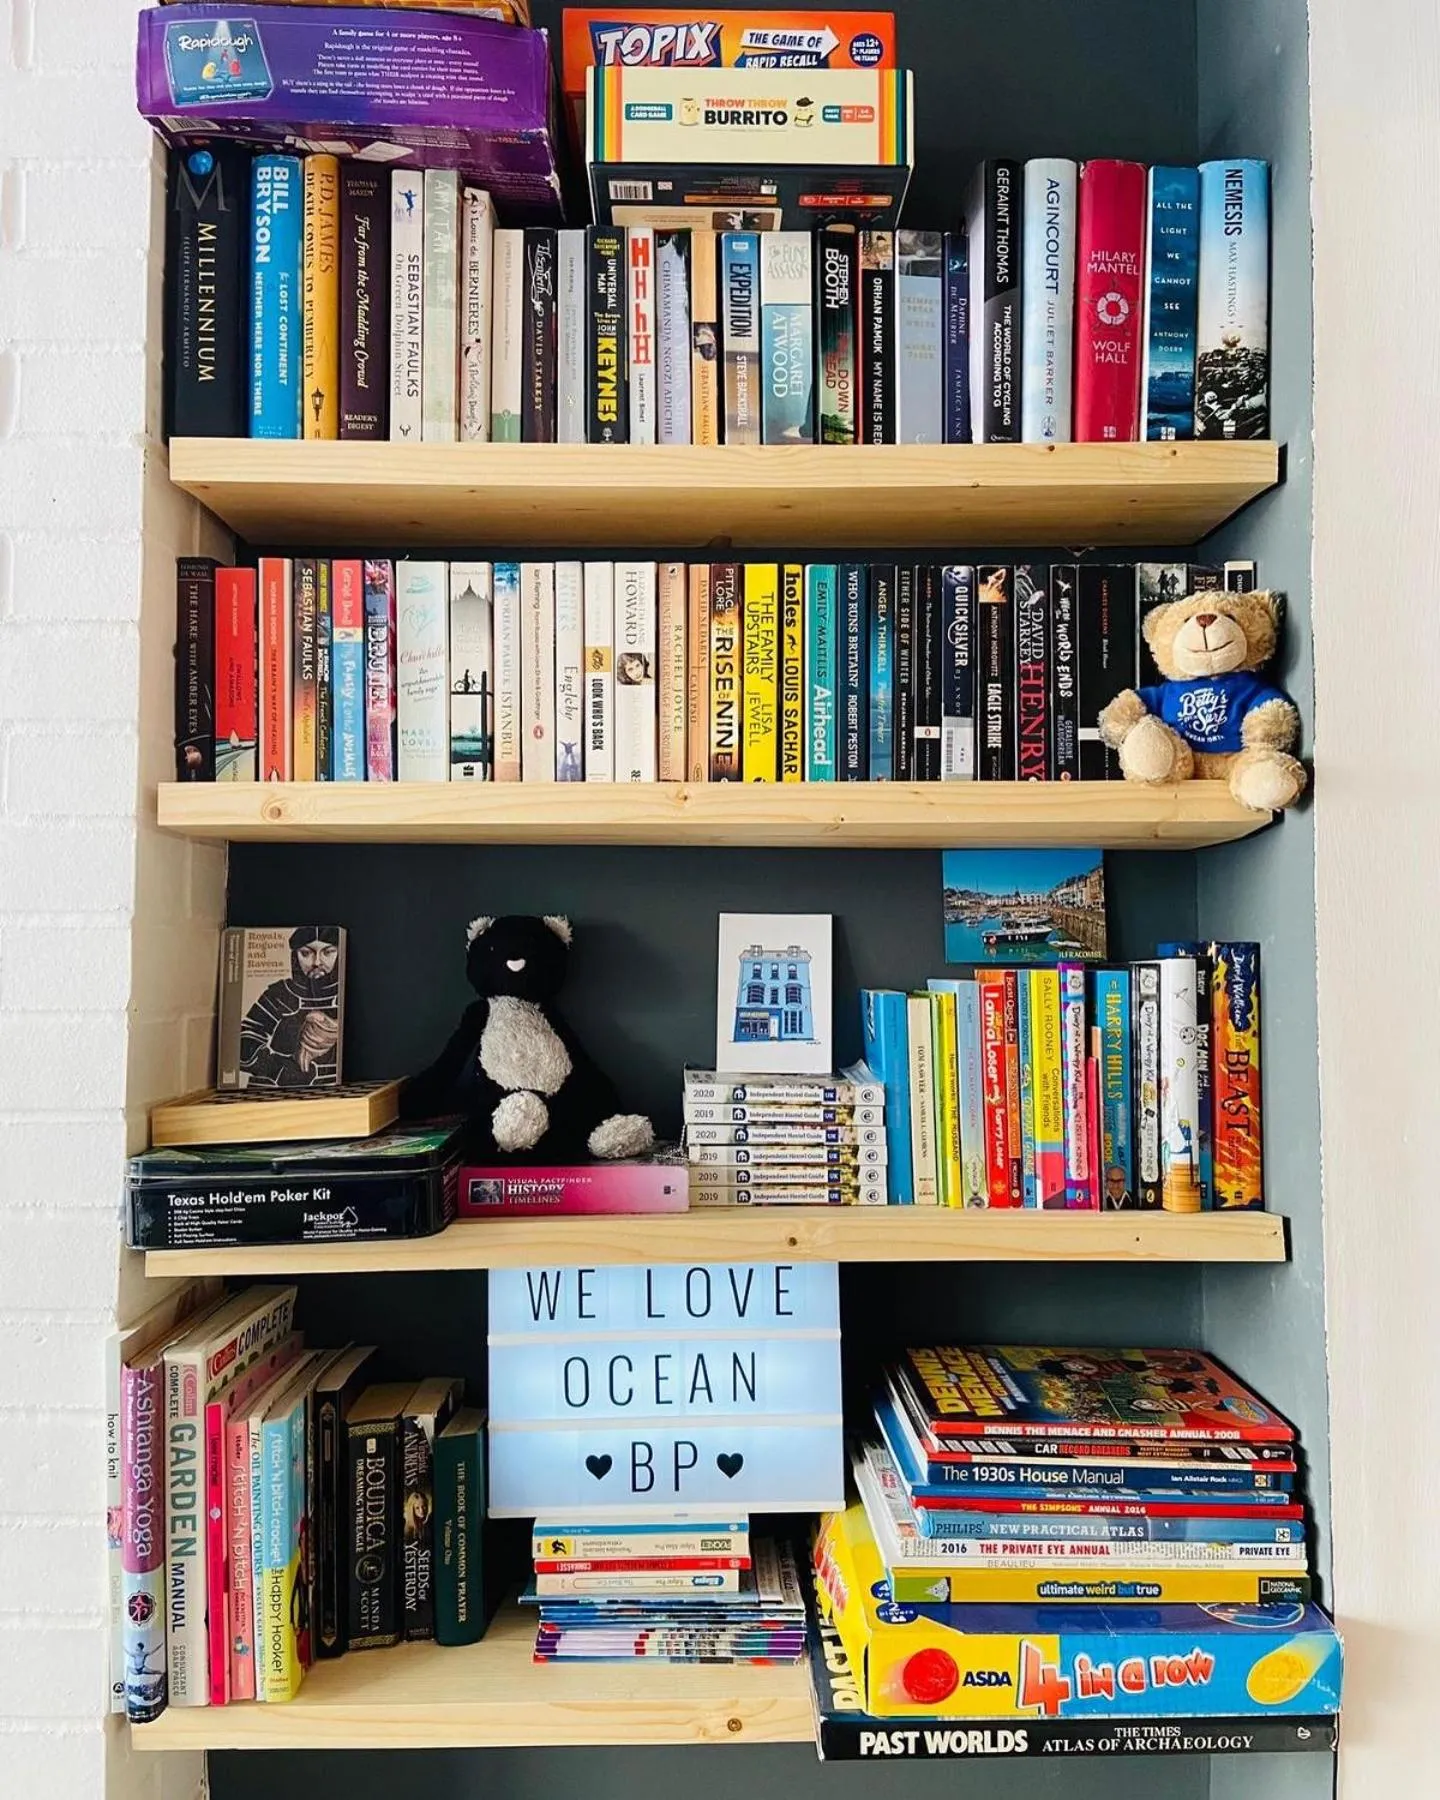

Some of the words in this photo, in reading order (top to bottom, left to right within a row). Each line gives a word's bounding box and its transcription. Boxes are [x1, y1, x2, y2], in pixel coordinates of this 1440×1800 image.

[178, 33, 254, 52] Rapidough
[600, 23, 715, 65] TOPIX
[749, 33, 767, 44] THE
[772, 34, 796, 46] GAME
[809, 37, 822, 47] OF
[746, 57, 776, 68] RAPID
[780, 56, 818, 67] RECALL
[704, 111, 787, 125] BURRITO
[705, 99, 744, 108] THROW
[748, 99, 787, 108] THROW
[273, 167, 288, 213] BILL
[997, 168, 1008, 225] GERAINT
[1224, 169, 1243, 236] NEMESIS
[255, 167, 270, 263] BRYSON
[1046, 178, 1059, 294] AGINCOURT
[997, 228, 1009, 283] THOMAS
[1087, 263, 1139, 275] MANTEL
[1091, 250, 1136, 263] HILARY
[407, 255, 419, 335] SEBASTIAN
[598, 273, 606, 294] MAN
[607, 259, 616, 308] UNIVERSAL
[825, 248, 838, 308] BOOTH
[839, 254, 848, 305] STEPHEN
[873, 278, 882, 314] ORHAN
[198, 222, 216, 382] MILLENNIUM
[730, 263, 752, 337] EXPEDITION
[1004, 305, 1012, 325] THE
[873, 317, 882, 353] PAMUK
[993, 322, 1002, 382] ACCORDING
[1003, 327, 1012, 364] WORLD
[1091, 340, 1130, 352] WOLF
[407, 341, 419, 397] FAULKS
[773, 311, 788, 397] ATWOOD
[790, 312, 802, 397] MARGARET
[874, 362, 881, 376] MY
[1095, 353, 1128, 364] HALL
[598, 337, 617, 422] KEYNES
[994, 384, 1001, 397] TO
[1003, 366, 1011, 380] OF
[874, 379, 882, 409] NAME
[993, 399, 1001, 407] G
[1002, 382, 1011, 425] CYCLING
[873, 424, 882, 445] RED
[874, 412, 882, 422] IS
[302, 568, 312, 632] SEBASTIAN
[786, 572, 800, 627] holes
[848, 571, 857, 594] WHO
[625, 571, 637, 645] HOWARD
[761, 592, 774, 624] THE
[848, 603, 858, 633] RUNS
[747, 601, 759, 675] UPSTAIRS
[1019, 601, 1031, 666] STARKEY
[1032, 609, 1044, 659] DAVID
[303, 636, 313, 680] FAULKS
[716, 637, 733, 691] RISE
[761, 629, 773, 683] FAMILY
[848, 636, 858, 687] BRITAIN?
[592, 679, 602, 699] LOOK
[785, 658, 798, 701] LOUIS
[987, 683, 1001, 711] EAGLE
[501, 691, 512, 758] ISTANBUL
[592, 701, 602, 727] WHO'S
[748, 691, 760, 747] JEWELL
[762, 704, 772, 735] LISA
[813, 684, 832, 765] Airhead
[848, 694, 857, 729] ROBERT
[1021, 662, 1044, 780] HENRY
[593, 730, 603, 750] BACK
[716, 700, 733, 766] NINE
[785, 709, 798, 774] SACHAR
[988, 714, 1001, 748] STRIKE
[848, 733, 857, 768] PESTON
[1043, 978, 1052, 1010] SALLY
[1045, 1015, 1054, 1061] ROONEY
[1106, 993, 1122, 1052] HARRY
[693, 1090, 714, 1098] 2020
[750, 1091, 783, 1099] Independent
[825, 1091, 834, 1099] UK
[1221, 1049, 1250, 1136] BEAST
[694, 1110, 713, 1118] 2019
[507, 1184, 565, 1195] HISTORY
[699, 1173, 718, 1181] 2019
[168, 1194, 205, 1206] Texas
[209, 1192, 266, 1204] Hold'em
[271, 1190, 308, 1202] Poker
[313, 1188, 331, 1200] Kit
[699, 1192, 718, 1201] 2019
[304, 1212, 344, 1222] Jackpot
[527, 1269, 596, 1320] WE
[647, 1266, 793, 1318] LOVE
[169, 1365, 179, 1419] COMPLETE
[564, 1352, 756, 1408] OCEAN
[107, 1413, 118, 1437] how
[134, 1380, 153, 1493] Ashtanga
[984, 1426, 1024, 1436] DENNIS
[1026, 1427, 1045, 1436] THE
[1048, 1427, 1092, 1437] MENACE
[1095, 1428, 1117, 1437] AND
[1120, 1428, 1164, 1438] GNASHER
[1167, 1429, 1210, 1438] ANNUAL
[1213, 1431, 1240, 1439] 2008
[107, 1440, 117, 1453] to
[1034, 1442, 1057, 1455] CAR
[107, 1457, 119, 1479] knit
[631, 1441, 698, 1493] BP
[943, 1466, 967, 1481] The
[971, 1467, 1015, 1482] 1930s
[1020, 1468, 1067, 1483] House
[1071, 1469, 1123, 1484] Manual
[169, 1423, 197, 1558] GARDEN
[365, 1458, 386, 1551] BOUDICA
[133, 1501, 154, 1557] Yoga
[936, 1521, 985, 1534] PHILIPS'
[989, 1523, 1019, 1535] NEW
[1023, 1524, 1098, 1536] PRACTICAL
[1101, 1525, 1144, 1537] ATLAS
[941, 1542, 967, 1554] 2016
[979, 1542, 999, 1554] THE
[1001, 1542, 1041, 1554] PRIVATE
[1044, 1543, 1066, 1554] EYE
[1069, 1543, 1110, 1554] ANNUAL
[1239, 1546, 1272, 1555] PRIVATE
[1275, 1546, 1290, 1555] EYE
[405, 1541, 418, 1611] YESTERDAY
[418, 1549, 430, 1587] SEEDS
[171, 1563, 186, 1633] MANUAL
[1039, 1584, 1084, 1596] ultimate
[1086, 1585, 1116, 1596] weird
[1117, 1585, 1135, 1595] but
[1136, 1584, 1159, 1596] true
[963, 1671, 1012, 1686] ASDA
[1019, 1641, 1067, 1715] 4
[1078, 1663, 1113, 1697] in
[1121, 1668, 1146, 1691] a
[1152, 1650, 1214, 1686] row
[860, 1731, 915, 1755] PAST
[919, 1730, 1028, 1753] WORLDS
[1043, 1739, 1092, 1751] ATLAS
[1095, 1739, 1119, 1751] OF
[1123, 1735, 1253, 1751] ARCHAEOLOGY
[1115, 1727, 1139, 1738] THE
[1142, 1727, 1181, 1737] TIMES
